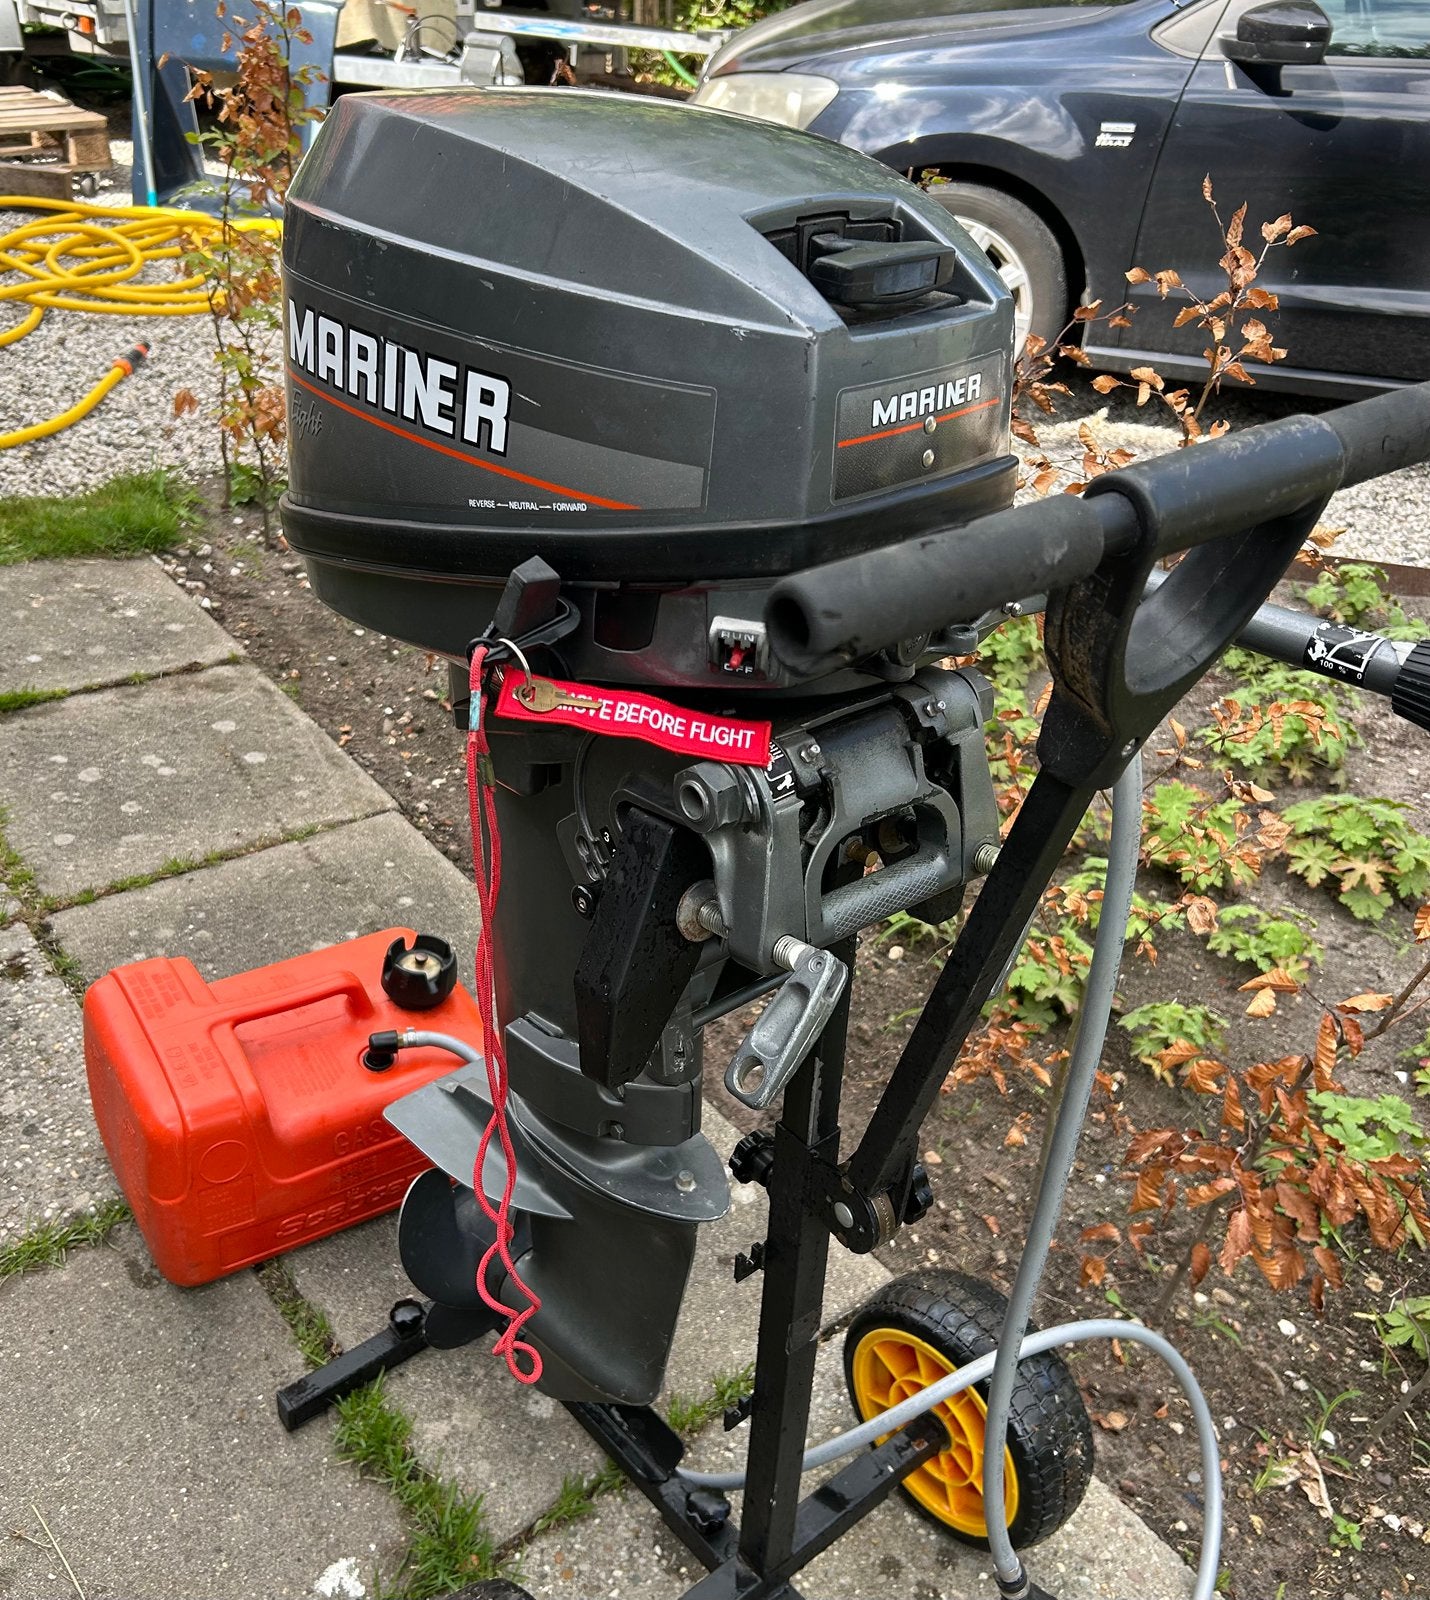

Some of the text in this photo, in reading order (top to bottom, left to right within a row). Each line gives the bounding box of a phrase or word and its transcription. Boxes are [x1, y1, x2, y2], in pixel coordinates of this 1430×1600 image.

[288, 298, 511, 456] MARINER
[872, 373, 982, 428] MARINER
[468, 499, 587, 512] REVERSE NEUTRAL FORWARD
[721, 630, 754, 642] RUN
[1319, 659, 1334, 670] 100
[1356, 672, 1363, 680] 0
[613, 701, 687, 738] BEFORE
[689, 721, 755, 749] FLIGHT
